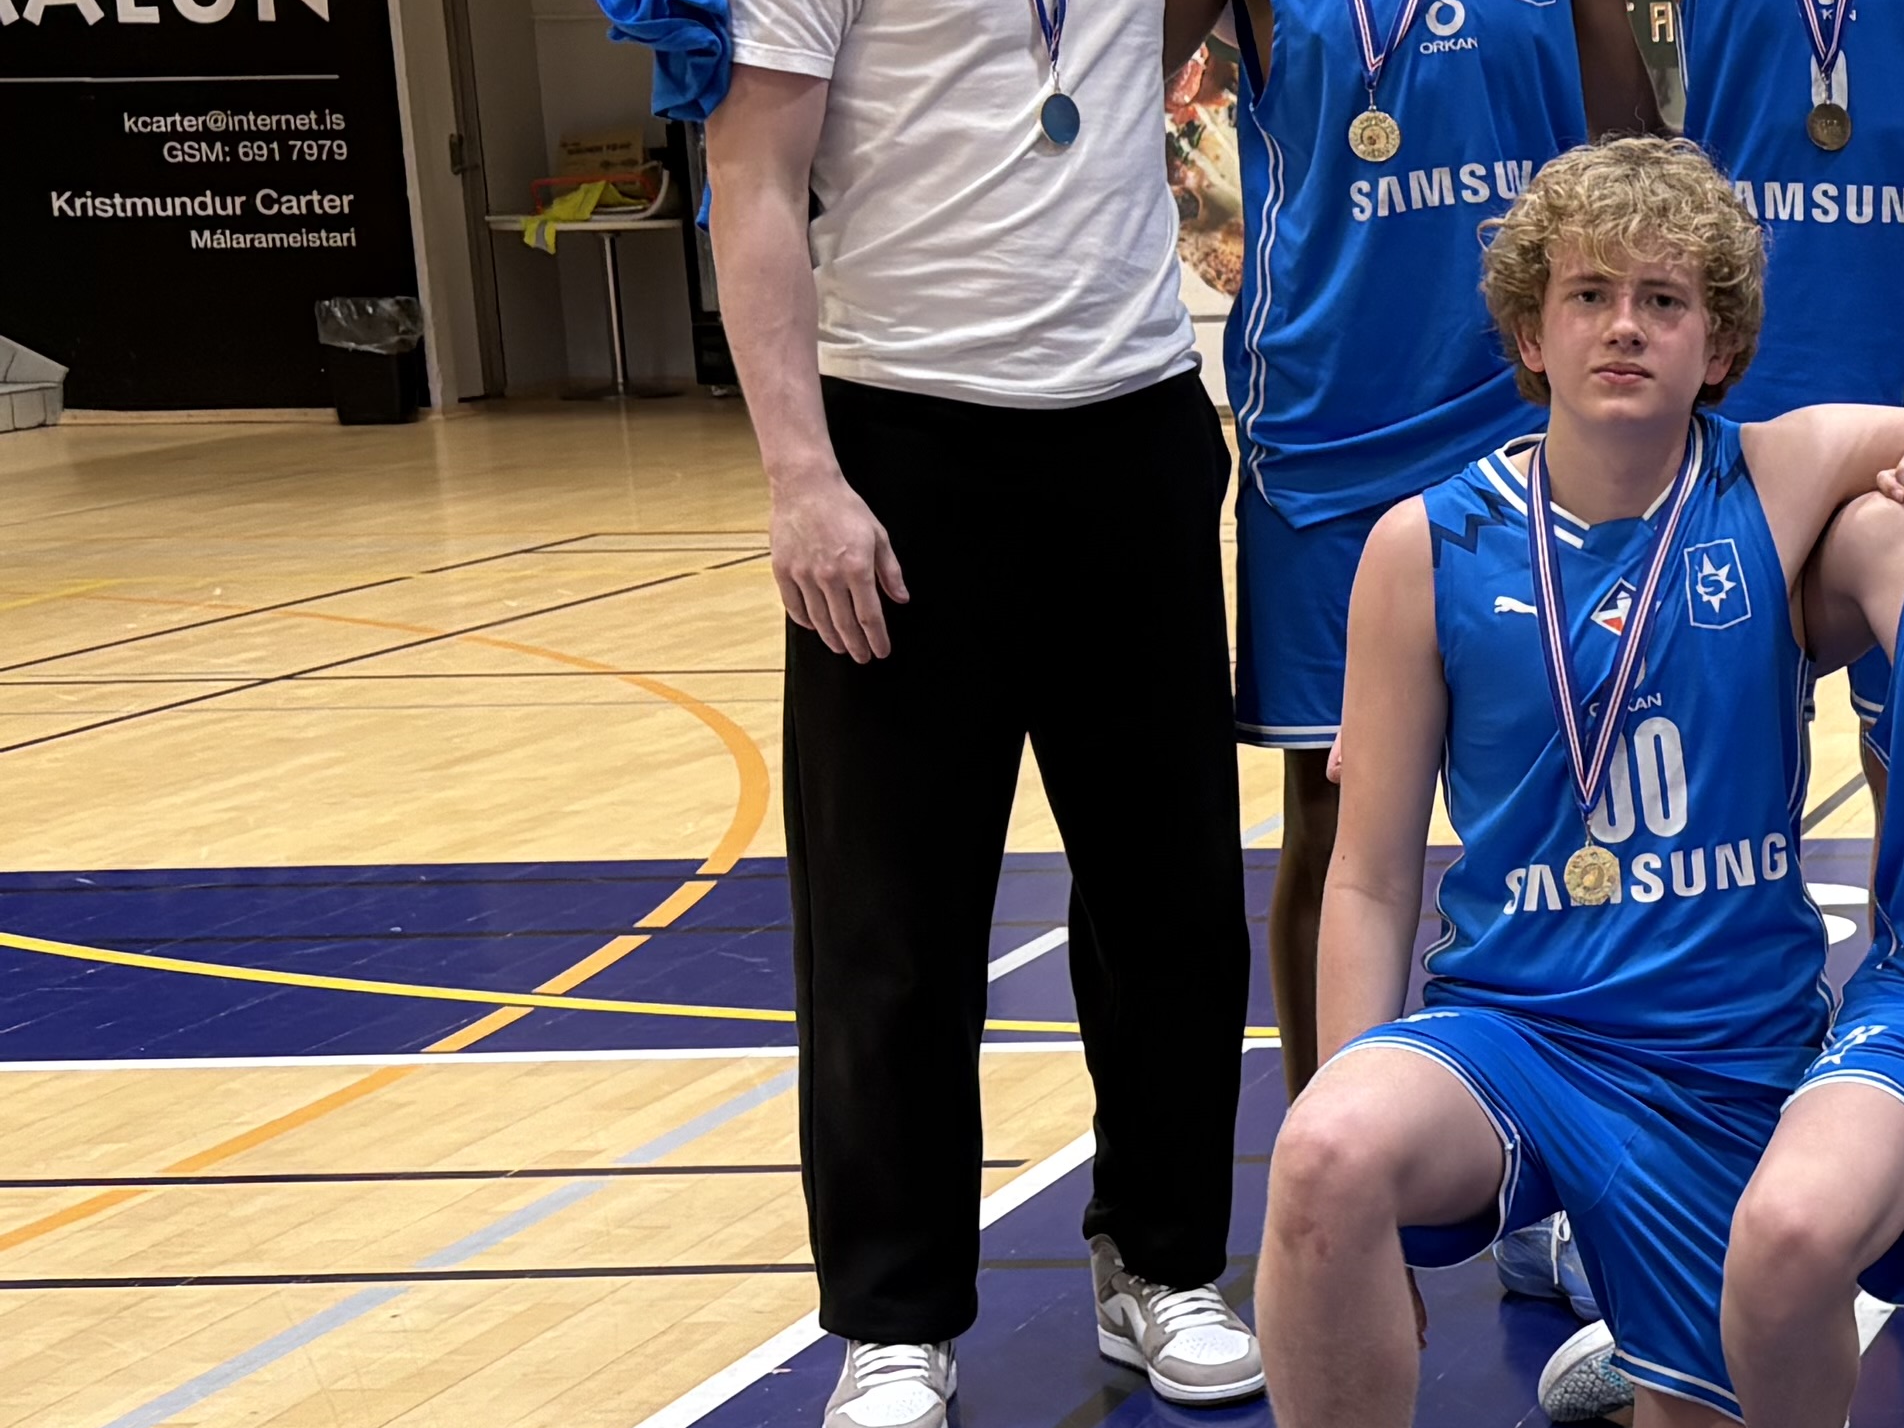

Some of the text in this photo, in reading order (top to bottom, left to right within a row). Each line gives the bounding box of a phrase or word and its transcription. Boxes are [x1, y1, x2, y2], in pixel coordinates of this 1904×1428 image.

[1419, 36, 1479, 55] ORKAN
[123, 110, 346, 135] kcarter@internet.is
[162, 140, 348, 163] GSM: 691 7979
[51, 189, 355, 219] Kristmundur Carter
[190, 227, 357, 250] Málarameistari
[1503, 832, 1788, 915] SASUNG
